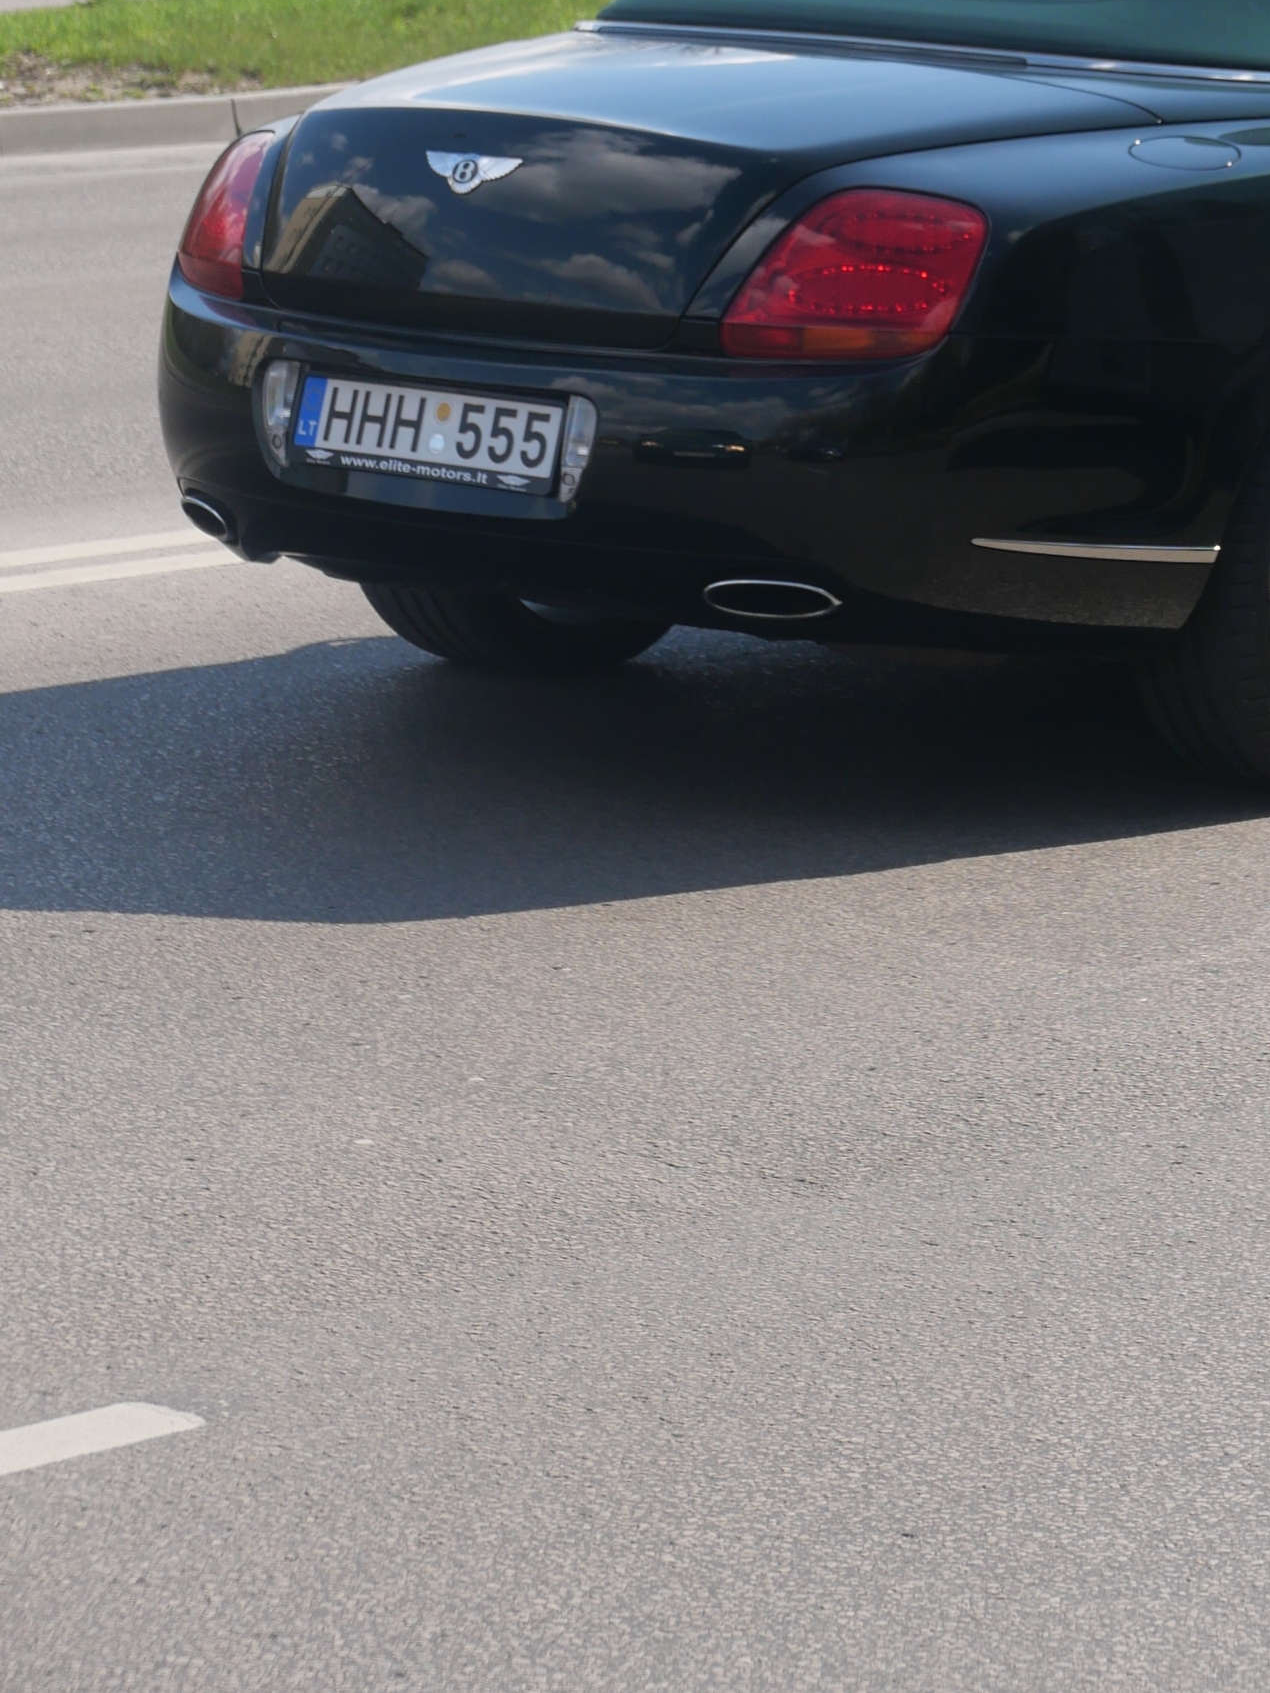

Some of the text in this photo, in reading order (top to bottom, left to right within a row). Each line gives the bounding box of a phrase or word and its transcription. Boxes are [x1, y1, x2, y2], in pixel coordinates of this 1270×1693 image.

[298, 419, 317, 436] LT
[323, 387, 551, 469] HHH 555
[340, 455, 488, 484] www.elite-motors.lt
